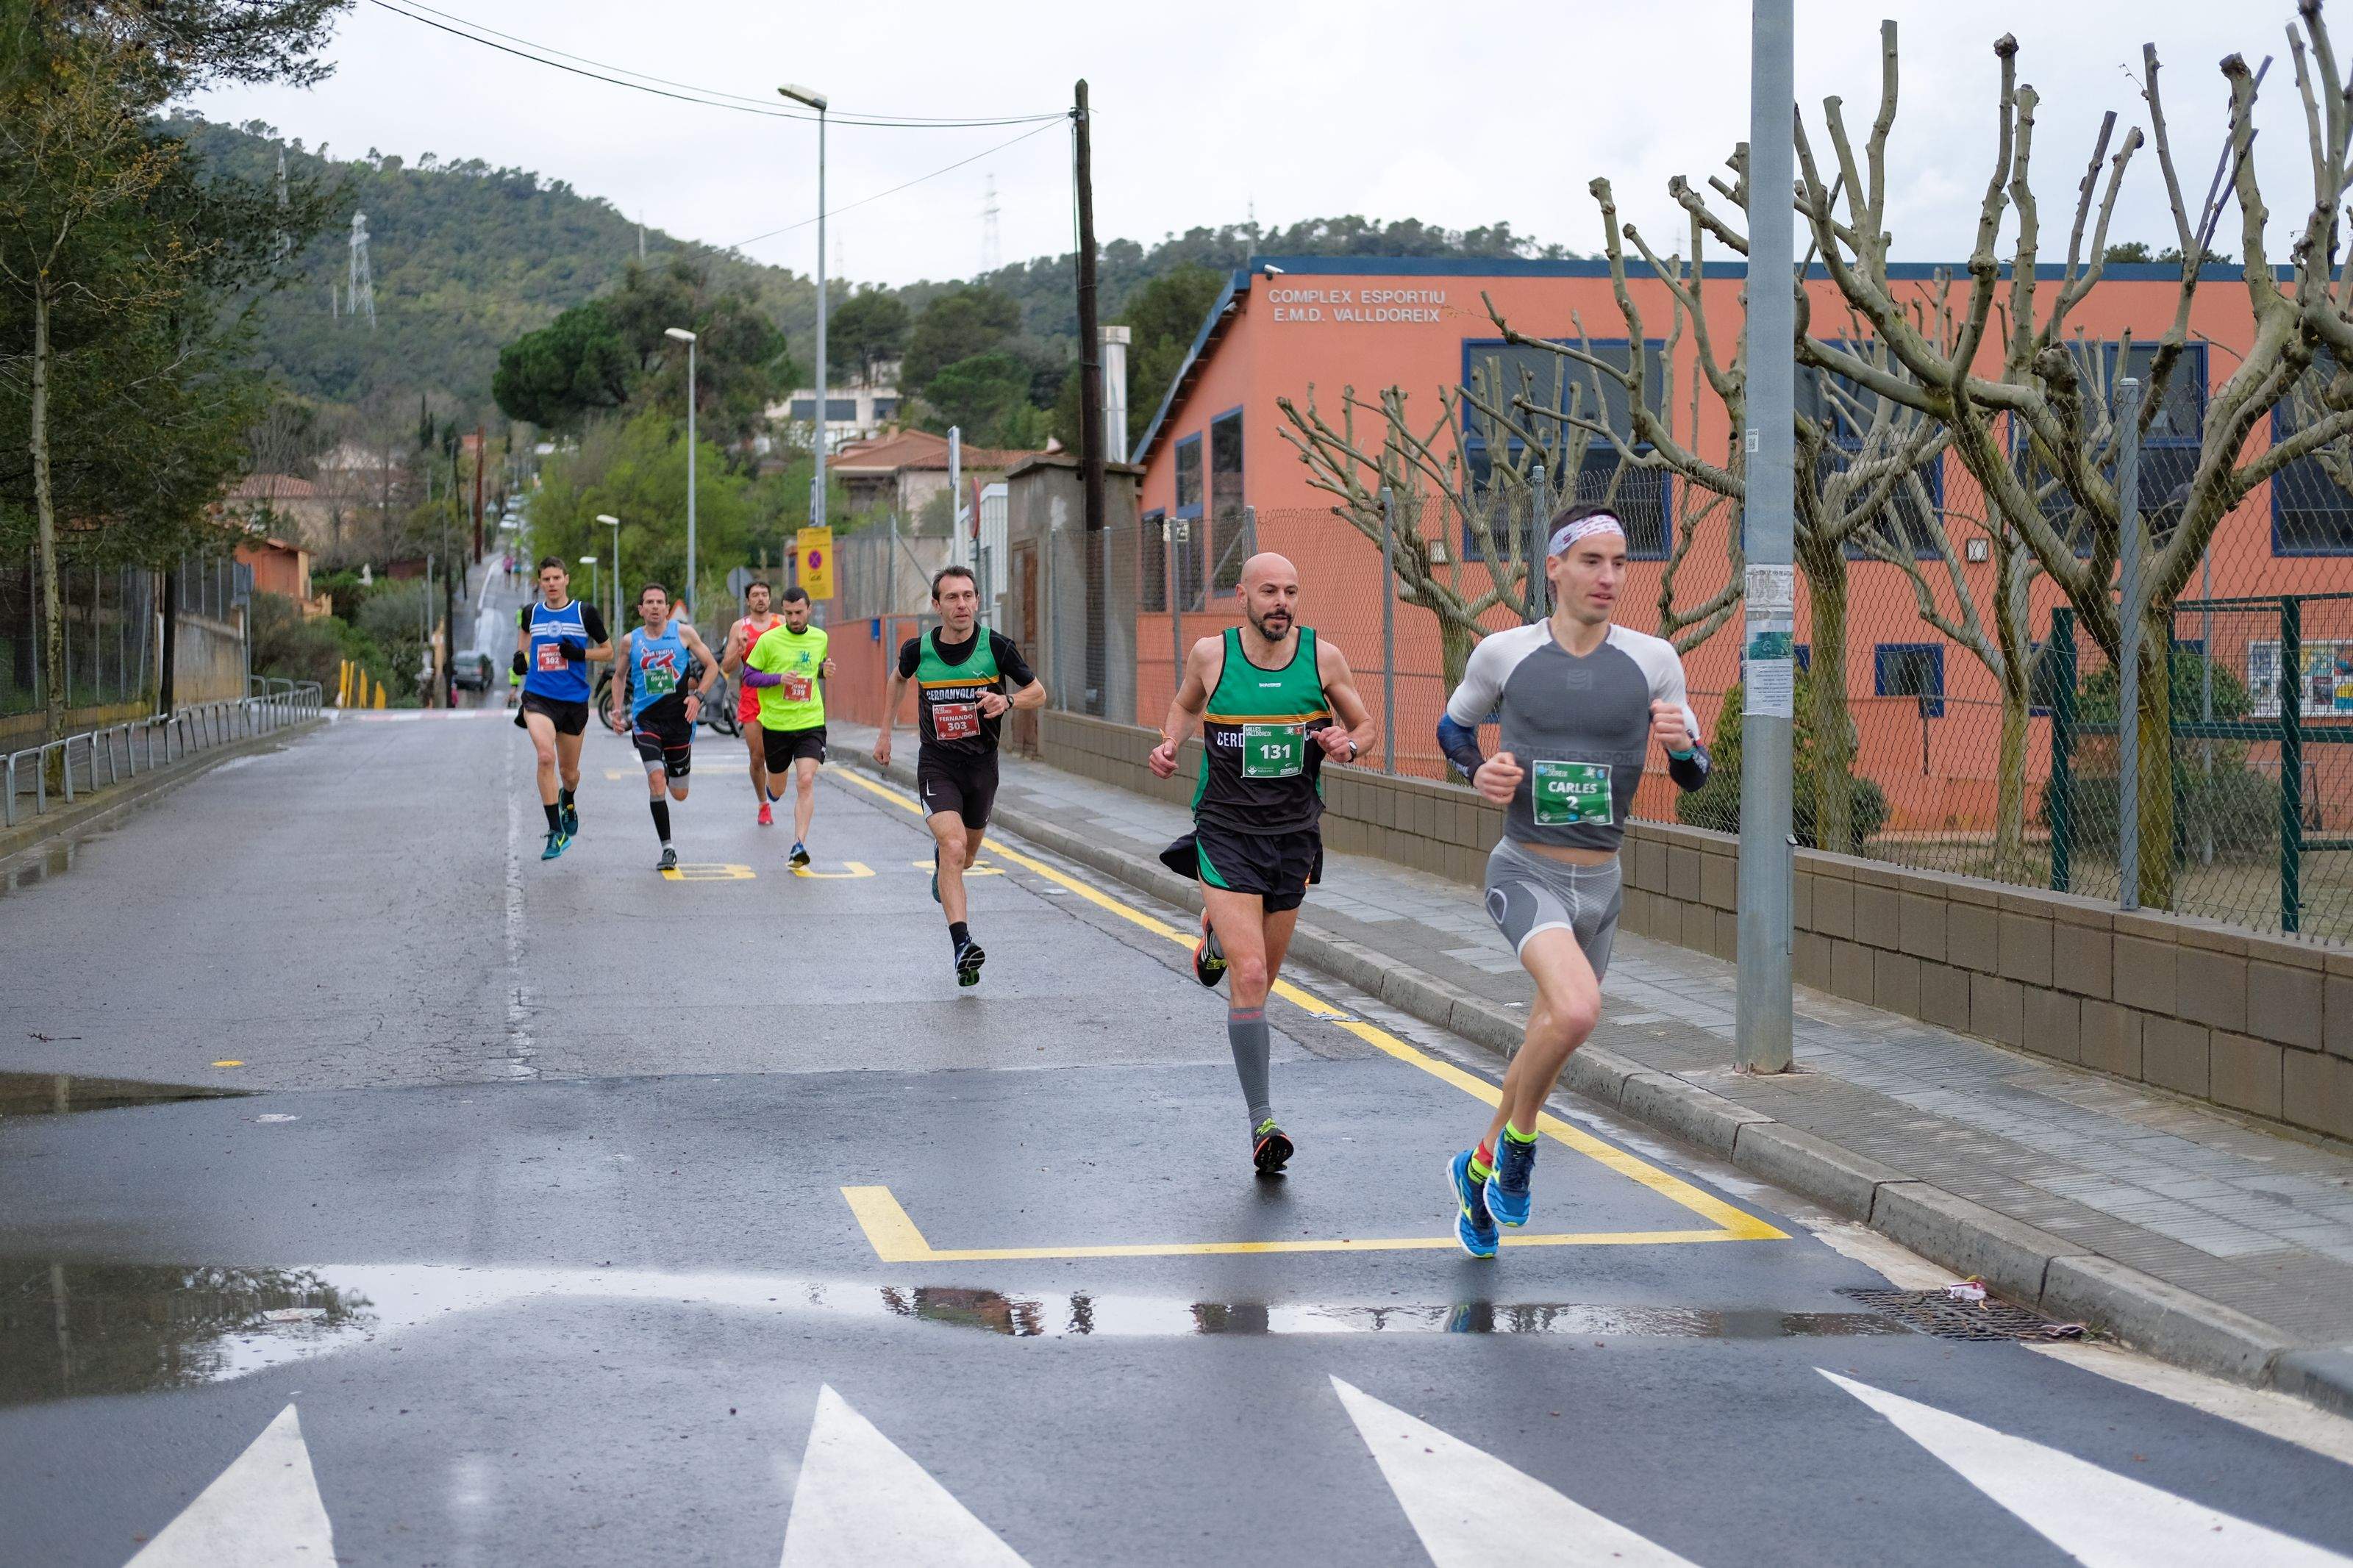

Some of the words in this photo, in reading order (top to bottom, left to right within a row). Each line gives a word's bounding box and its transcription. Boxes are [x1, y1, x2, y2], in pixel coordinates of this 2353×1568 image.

[1268, 290, 1352, 304] COMPLEX
[1360, 290, 1446, 304] ESPORTIU
[1274, 308, 1325, 322] E.M.D.
[1333, 309, 1440, 323] VALLDOREIX
[939, 714, 973, 722] FERNANDO
[948, 722, 967, 731] 303
[1260, 744, 1290, 759] 131
[1548, 781, 1598, 794] CARLES
[1565, 795, 1579, 809] 2
